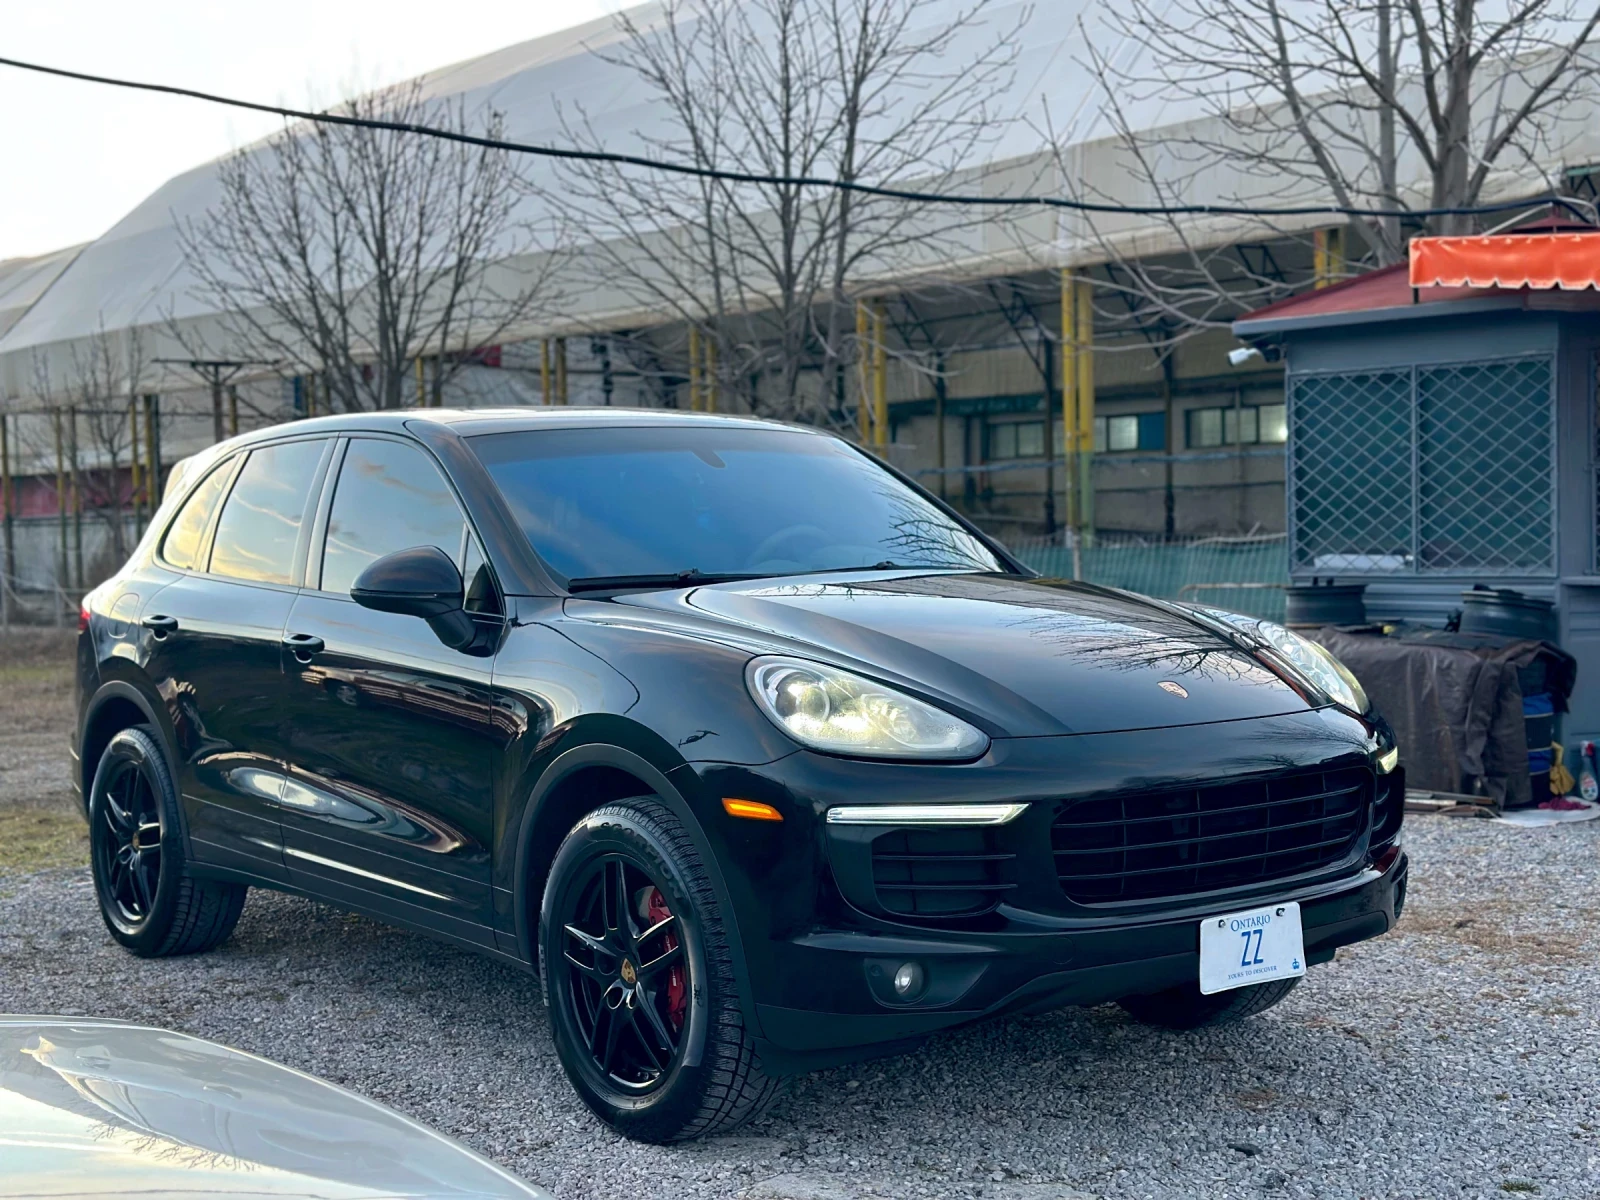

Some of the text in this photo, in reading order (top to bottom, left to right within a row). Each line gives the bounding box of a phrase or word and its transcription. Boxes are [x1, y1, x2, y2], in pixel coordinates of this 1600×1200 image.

[1241, 929, 1263, 966] ZZ
[1228, 972, 1244, 980] YOURS
[1253, 966, 1277, 974] DISCOVER
